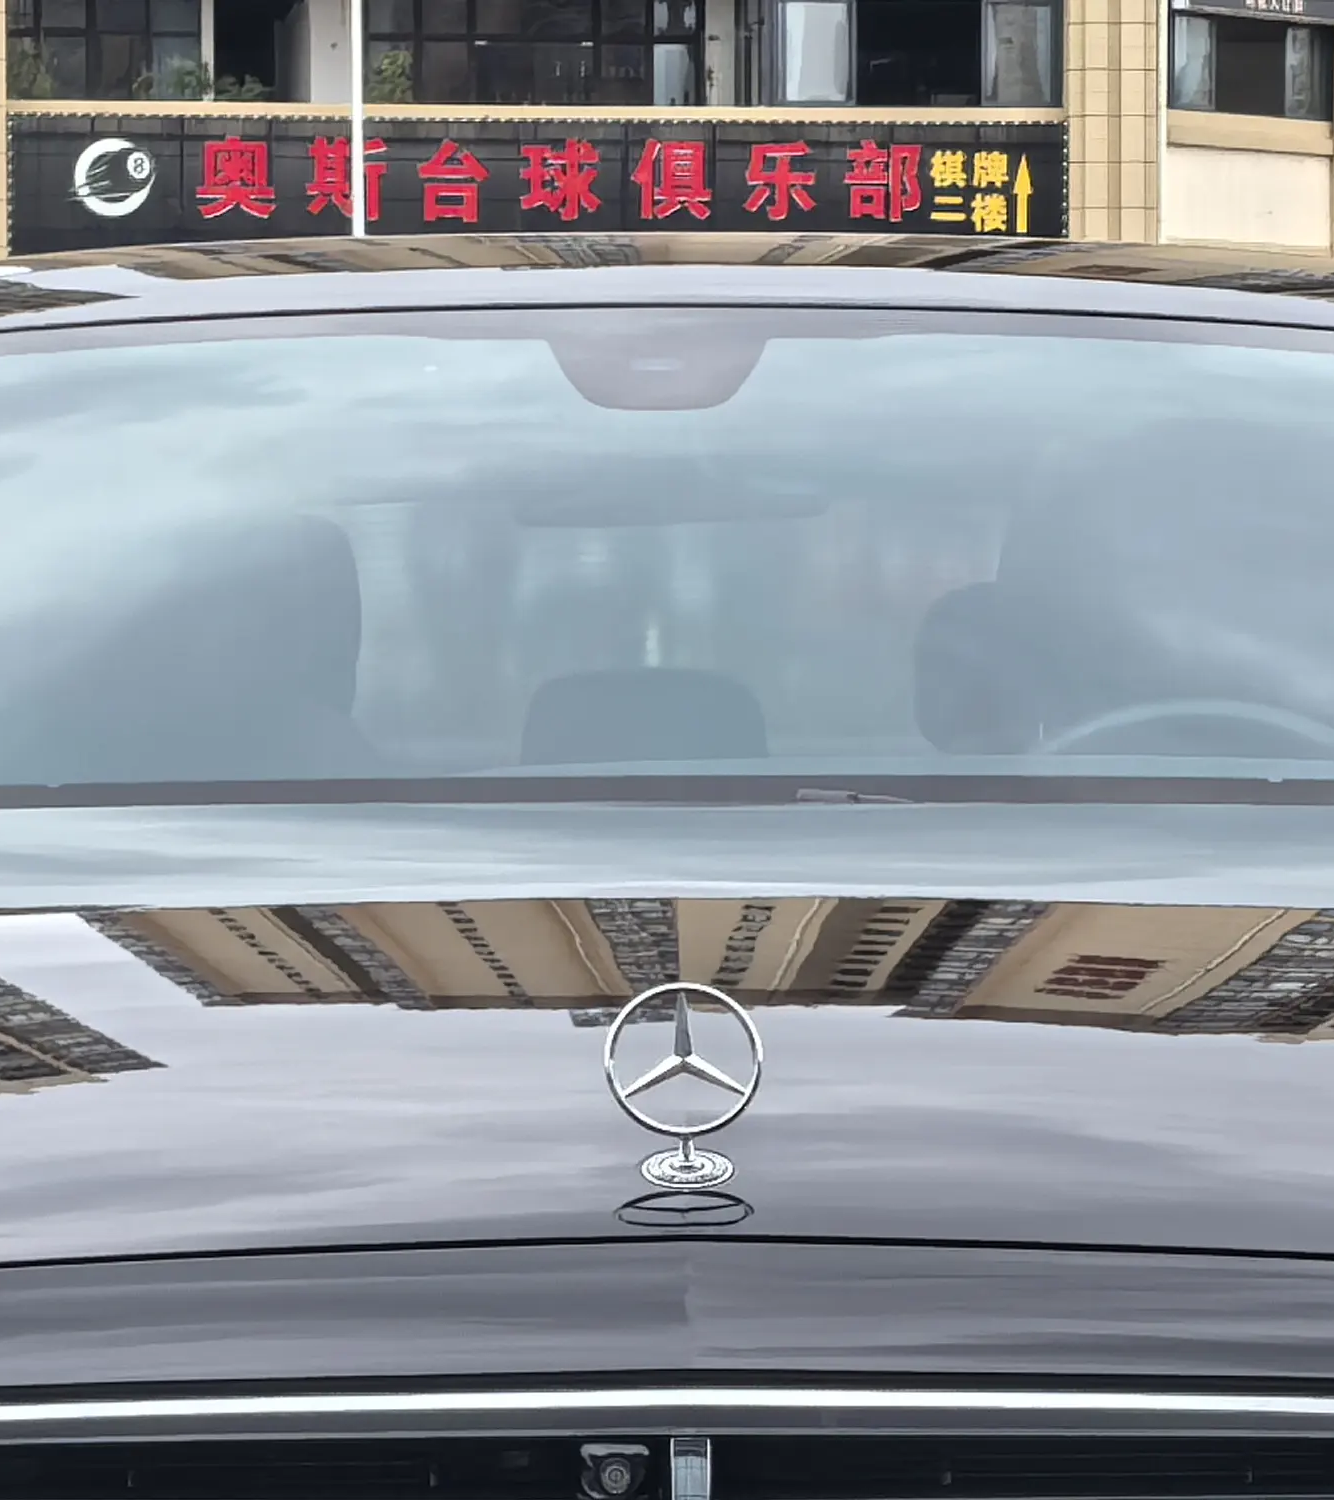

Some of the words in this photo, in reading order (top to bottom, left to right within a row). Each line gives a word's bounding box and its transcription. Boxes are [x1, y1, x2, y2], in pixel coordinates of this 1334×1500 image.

[196, 136, 922, 222] 奥斯台球俱乐部
[929, 150, 1010, 188] 棋牌
[930, 194, 1009, 233] 二楼
